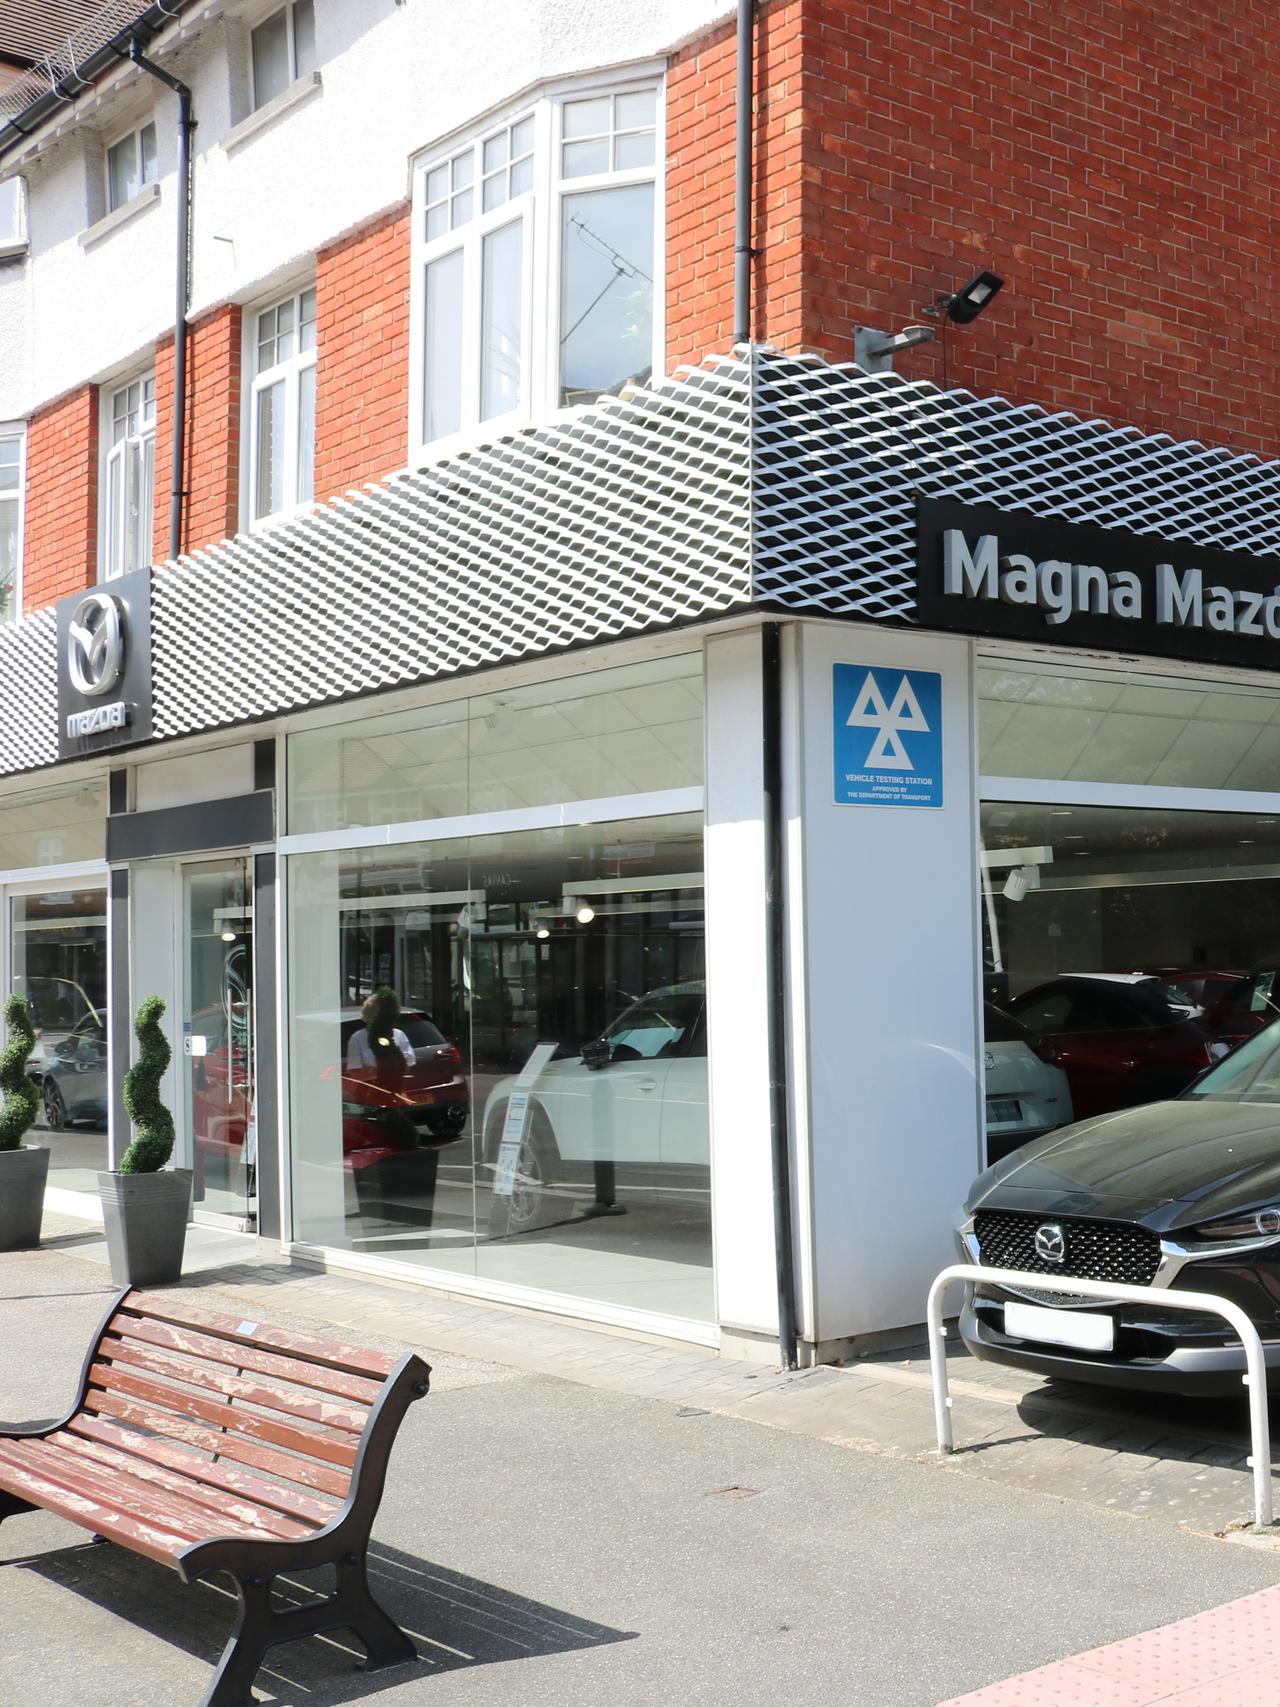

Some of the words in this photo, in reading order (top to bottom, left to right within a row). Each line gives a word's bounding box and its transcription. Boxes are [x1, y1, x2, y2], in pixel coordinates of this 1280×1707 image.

[943, 529, 1142, 625] Magna
[845, 774, 874, 783] VEHICLE
[876, 775, 904, 784] TESTING
[905, 777, 933, 785] STATION
[847, 791, 858, 799] THE
[859, 792, 892, 800] DEPARTMENT
[901, 793, 931, 801] TRANSPORT
